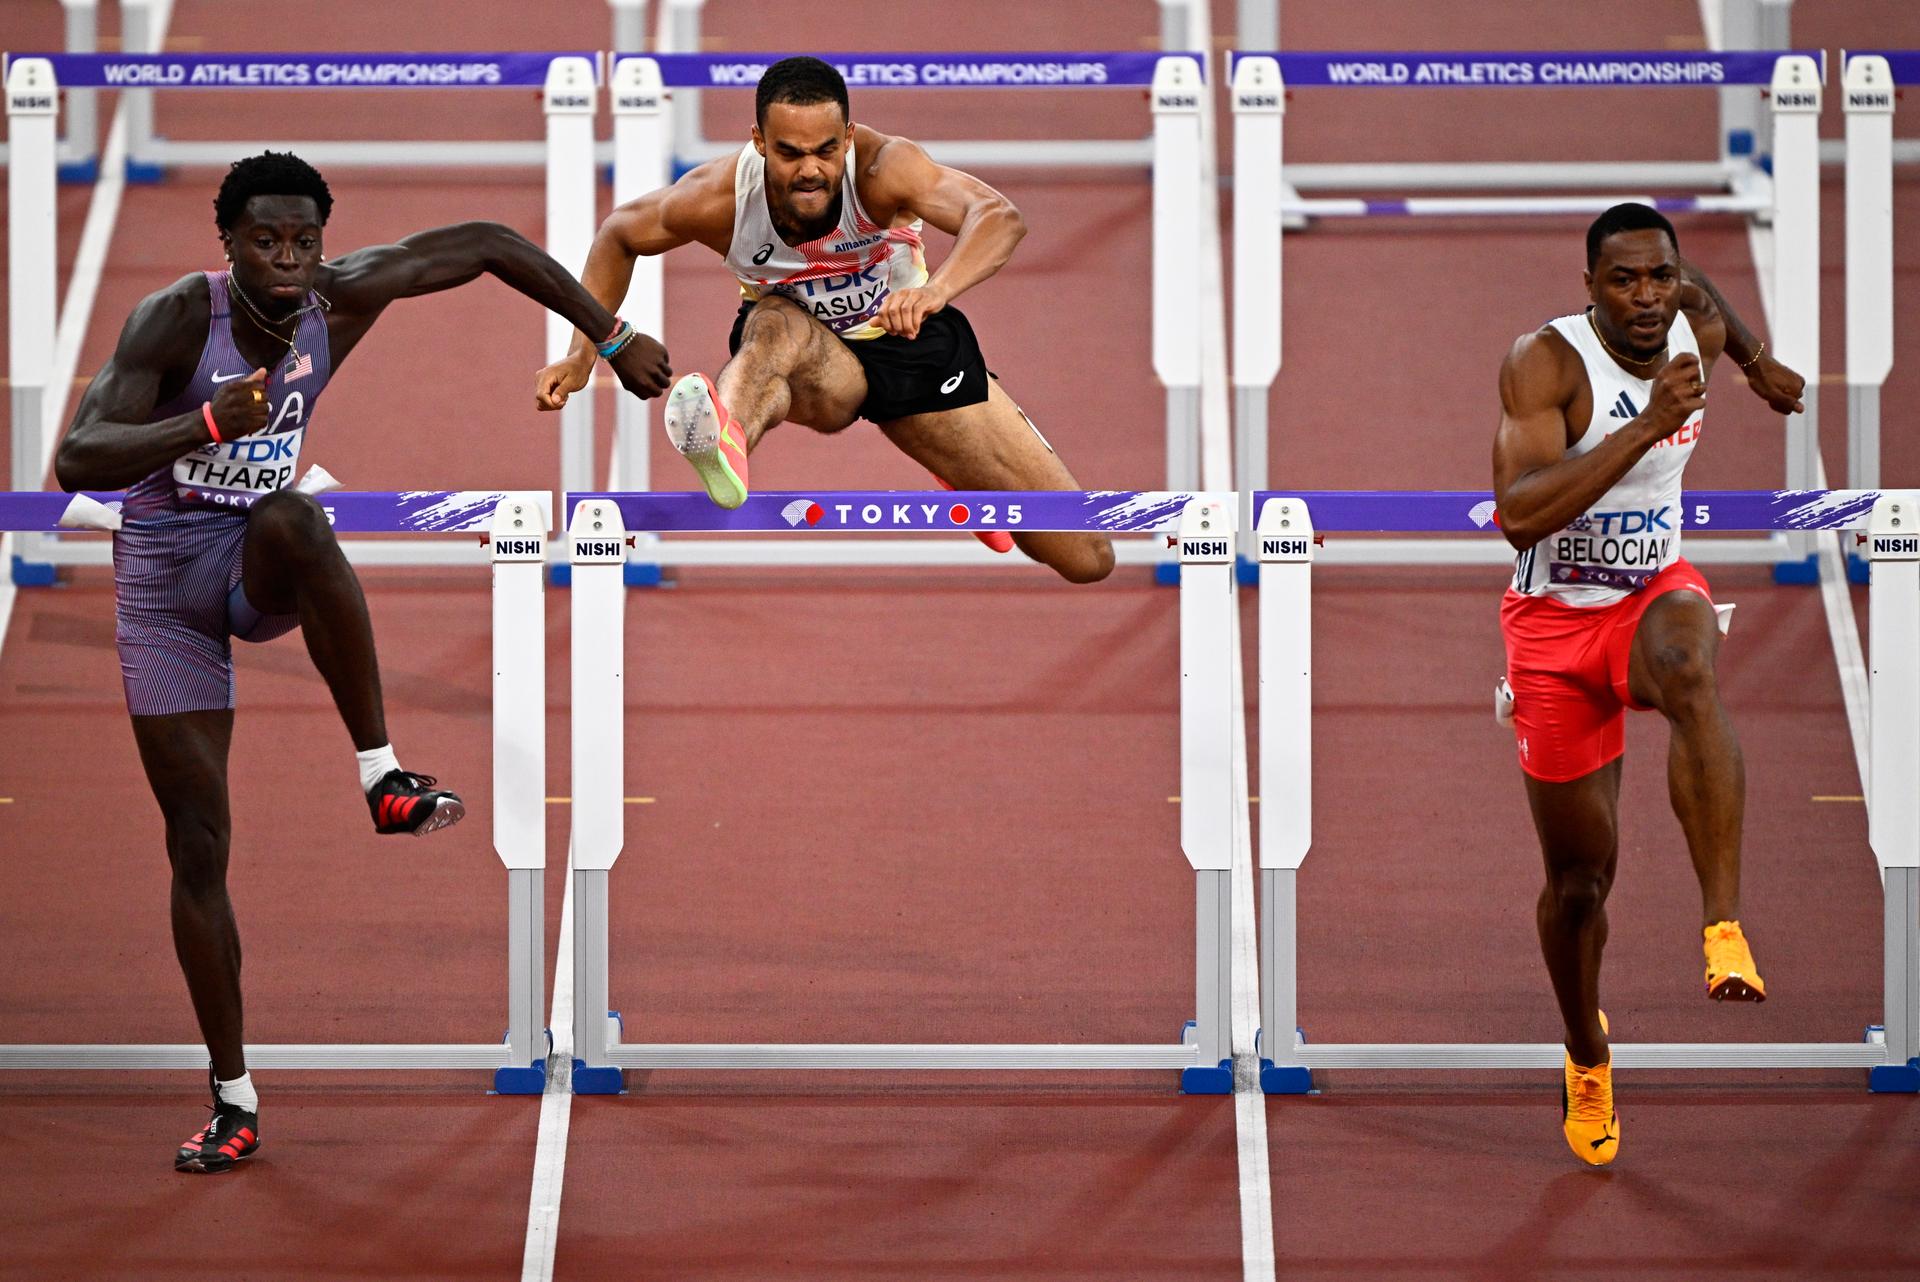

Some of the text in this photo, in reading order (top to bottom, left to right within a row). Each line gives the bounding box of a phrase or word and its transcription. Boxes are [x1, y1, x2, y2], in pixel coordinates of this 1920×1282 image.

[104, 64, 501, 83] WORLD ATHLETICS CHAMPIONSHIPS
[709, 63, 1107, 83] WOR LETICS CHAMPIONSHIPS
[1328, 62, 1724, 82] WORLD ATHLETICS CHAMPIONSHIPS
[12, 97, 51, 108] NISHI
[1777, 95, 1816, 106] NISHI
[1850, 95, 1889, 106] NISHI
[835, 238, 872, 253] Allianz
[228, 434, 296, 462] TDK
[186, 458, 291, 489] THARP
[202, 492, 255, 508] TOKY
[1594, 506, 1671, 535] TDK
[496, 541, 540, 554] NISHI
[576, 543, 620, 556] NISHI
[1184, 542, 1227, 555] NISHI
[1263, 541, 1307, 554] NISHI
[1558, 537, 1670, 565] BELOCIAN
[1874, 539, 1918, 552] NISHI
